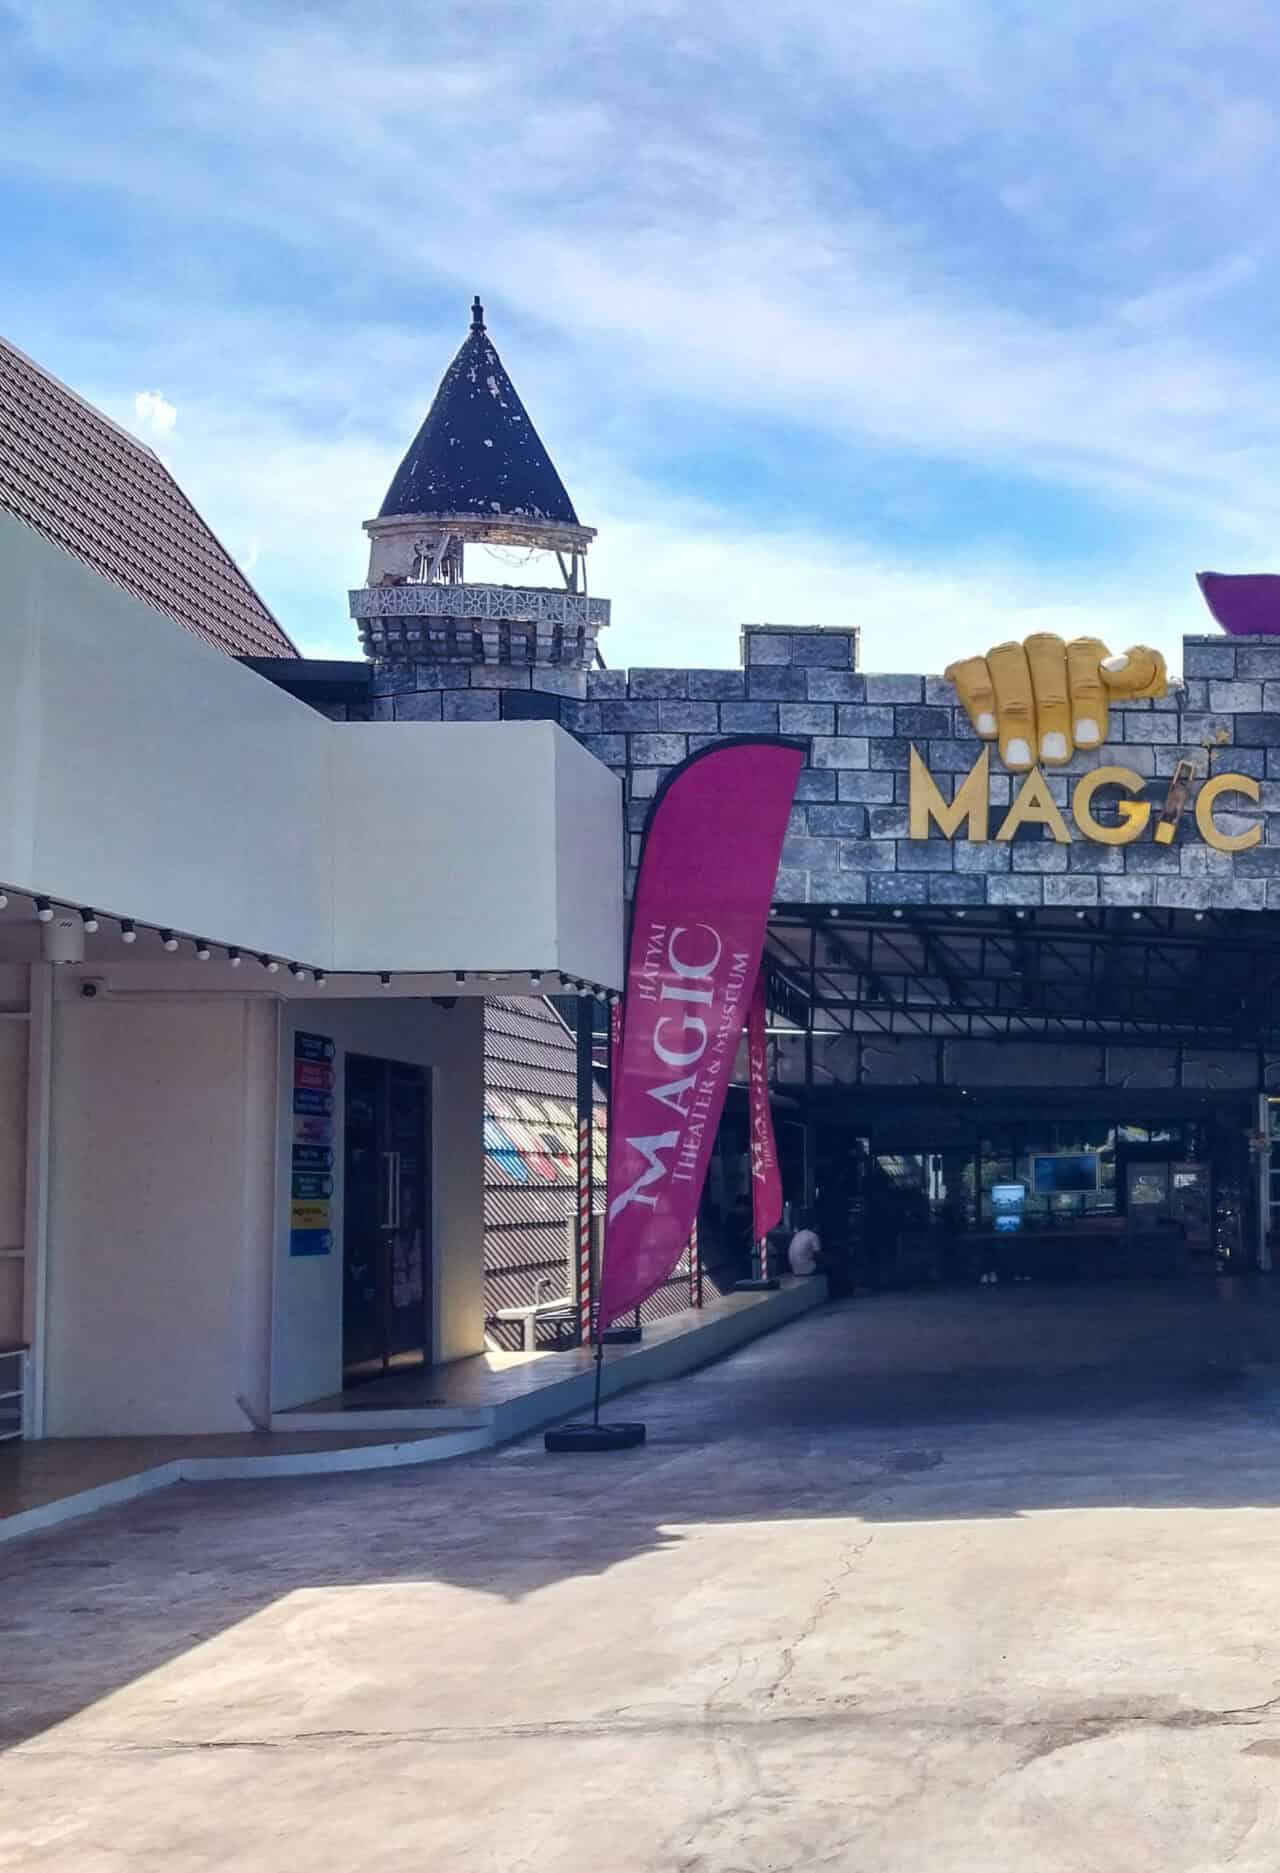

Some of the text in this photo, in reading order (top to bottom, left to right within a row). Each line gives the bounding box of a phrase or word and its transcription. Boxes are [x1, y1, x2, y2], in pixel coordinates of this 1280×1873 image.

[909, 741, 1263, 851] MAGIC
[638, 924, 666, 1002] HATYAI
[609, 922, 721, 1224] MAGIC
[672, 1080, 715, 1184] THEATER
[712, 952, 749, 1056] MUSEUM
